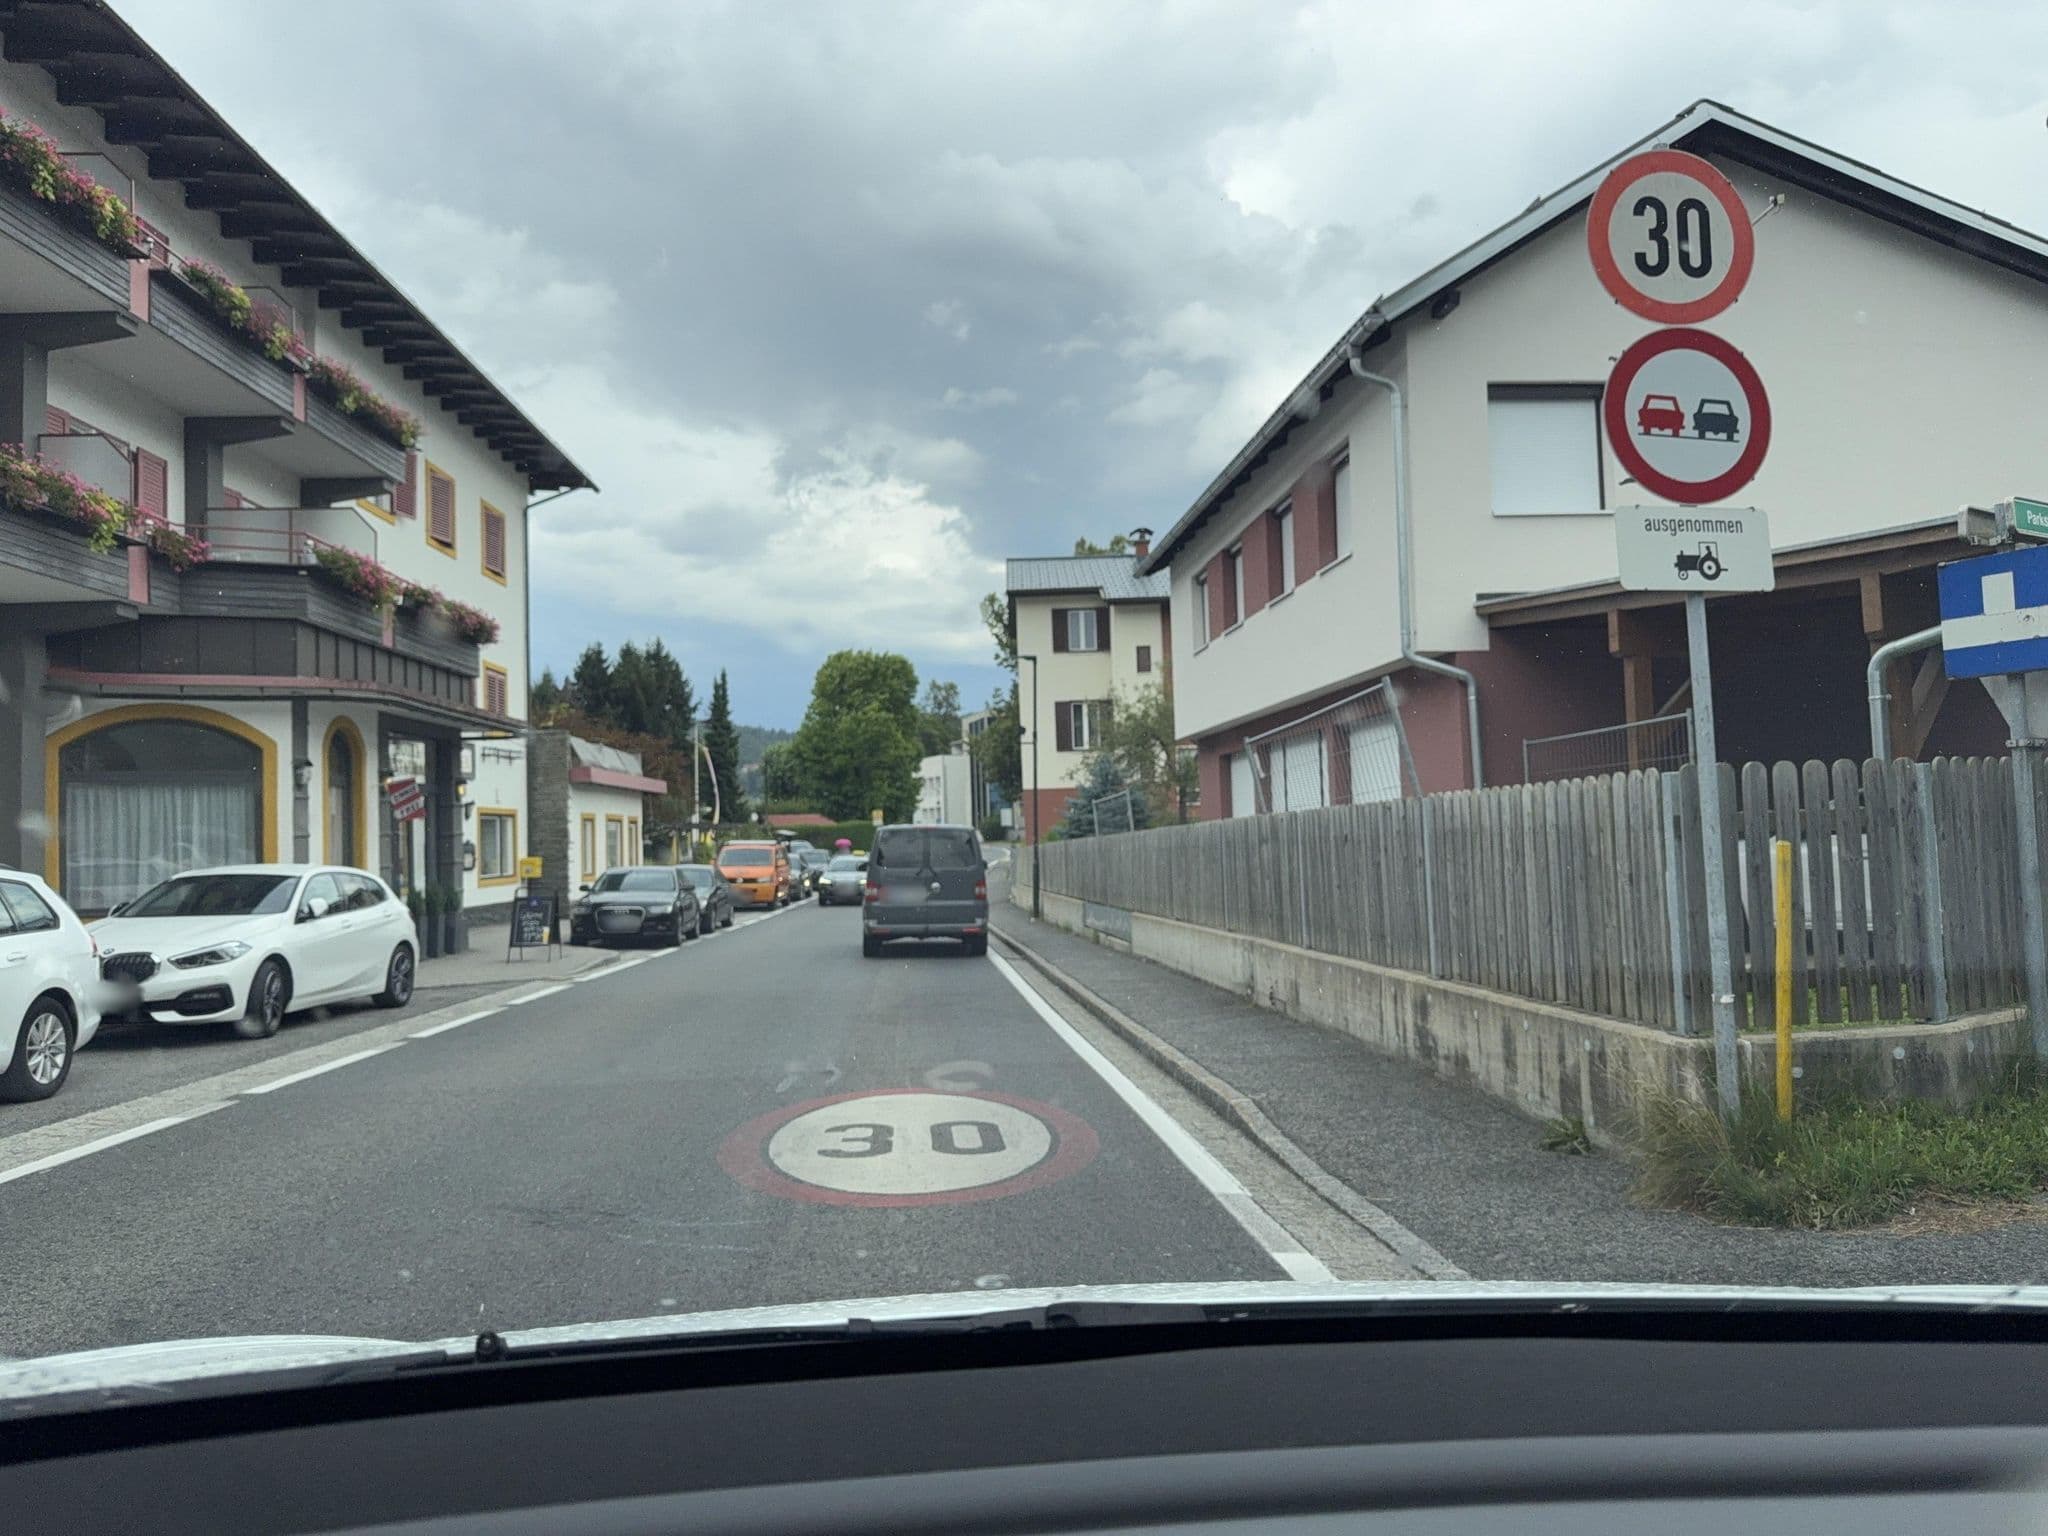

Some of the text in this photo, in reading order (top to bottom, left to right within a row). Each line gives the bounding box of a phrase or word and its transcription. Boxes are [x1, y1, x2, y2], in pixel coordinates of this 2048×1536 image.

[1633, 196, 1712, 278] 30
[1644, 517, 1743, 536] ausgenommen
[817, 1121, 1007, 1158] 30
